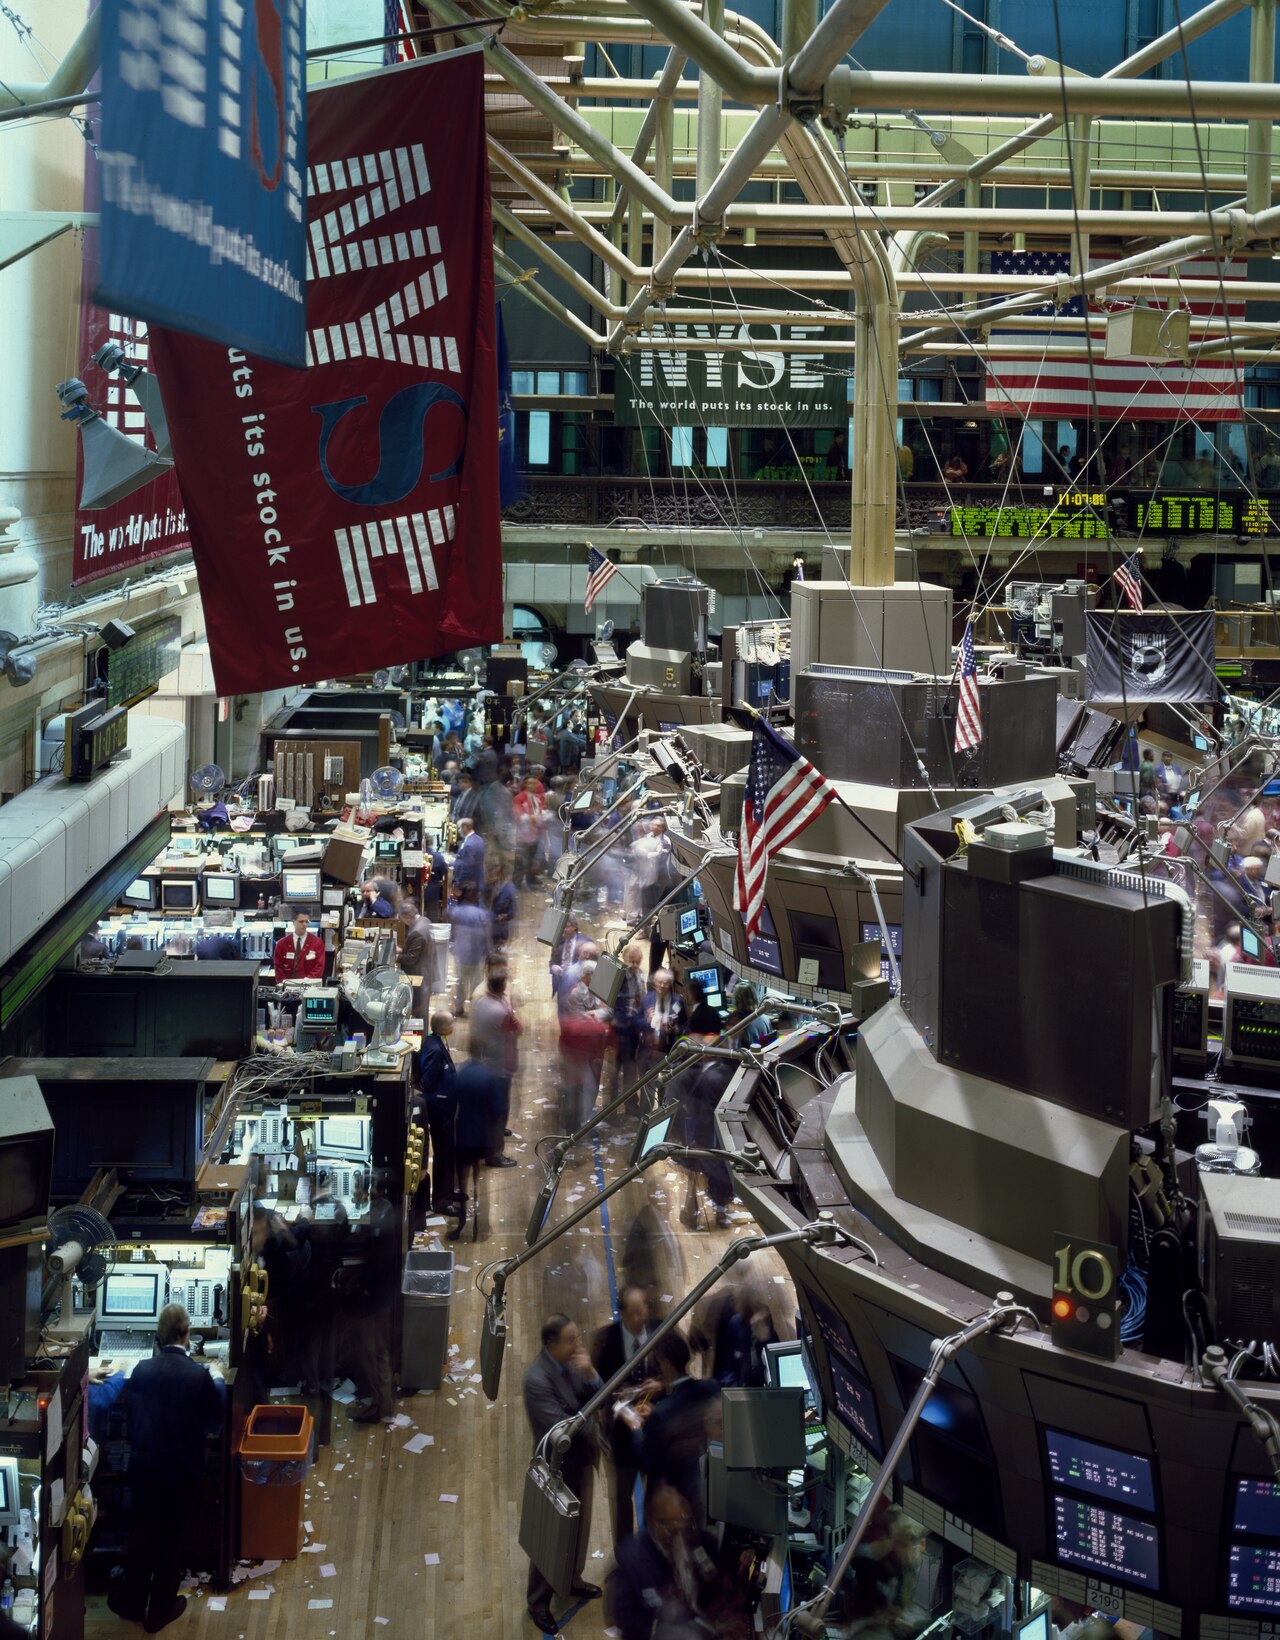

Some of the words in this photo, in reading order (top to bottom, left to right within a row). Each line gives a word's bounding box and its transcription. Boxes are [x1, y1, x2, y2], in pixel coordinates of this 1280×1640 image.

[228, 346, 253, 399] uts
[641, 323, 824, 389] NYSE
[630, 399, 654, 409] The
[660, 399, 696, 410] world
[702, 401, 730, 411] puts
[735, 400, 752, 410] its
[757, 401, 792, 411] stock
[797, 401, 809, 411] in
[241, 413, 266, 457] its
[253, 471, 291, 567] stock
[81, 523, 105, 560] The
[274, 579, 297, 612] in
[284, 626, 308, 673] us.
[666, 667, 674, 681] 5
[1055, 1244, 1113, 1299] 10
[1091, 1592, 1119, 1609] 2190
